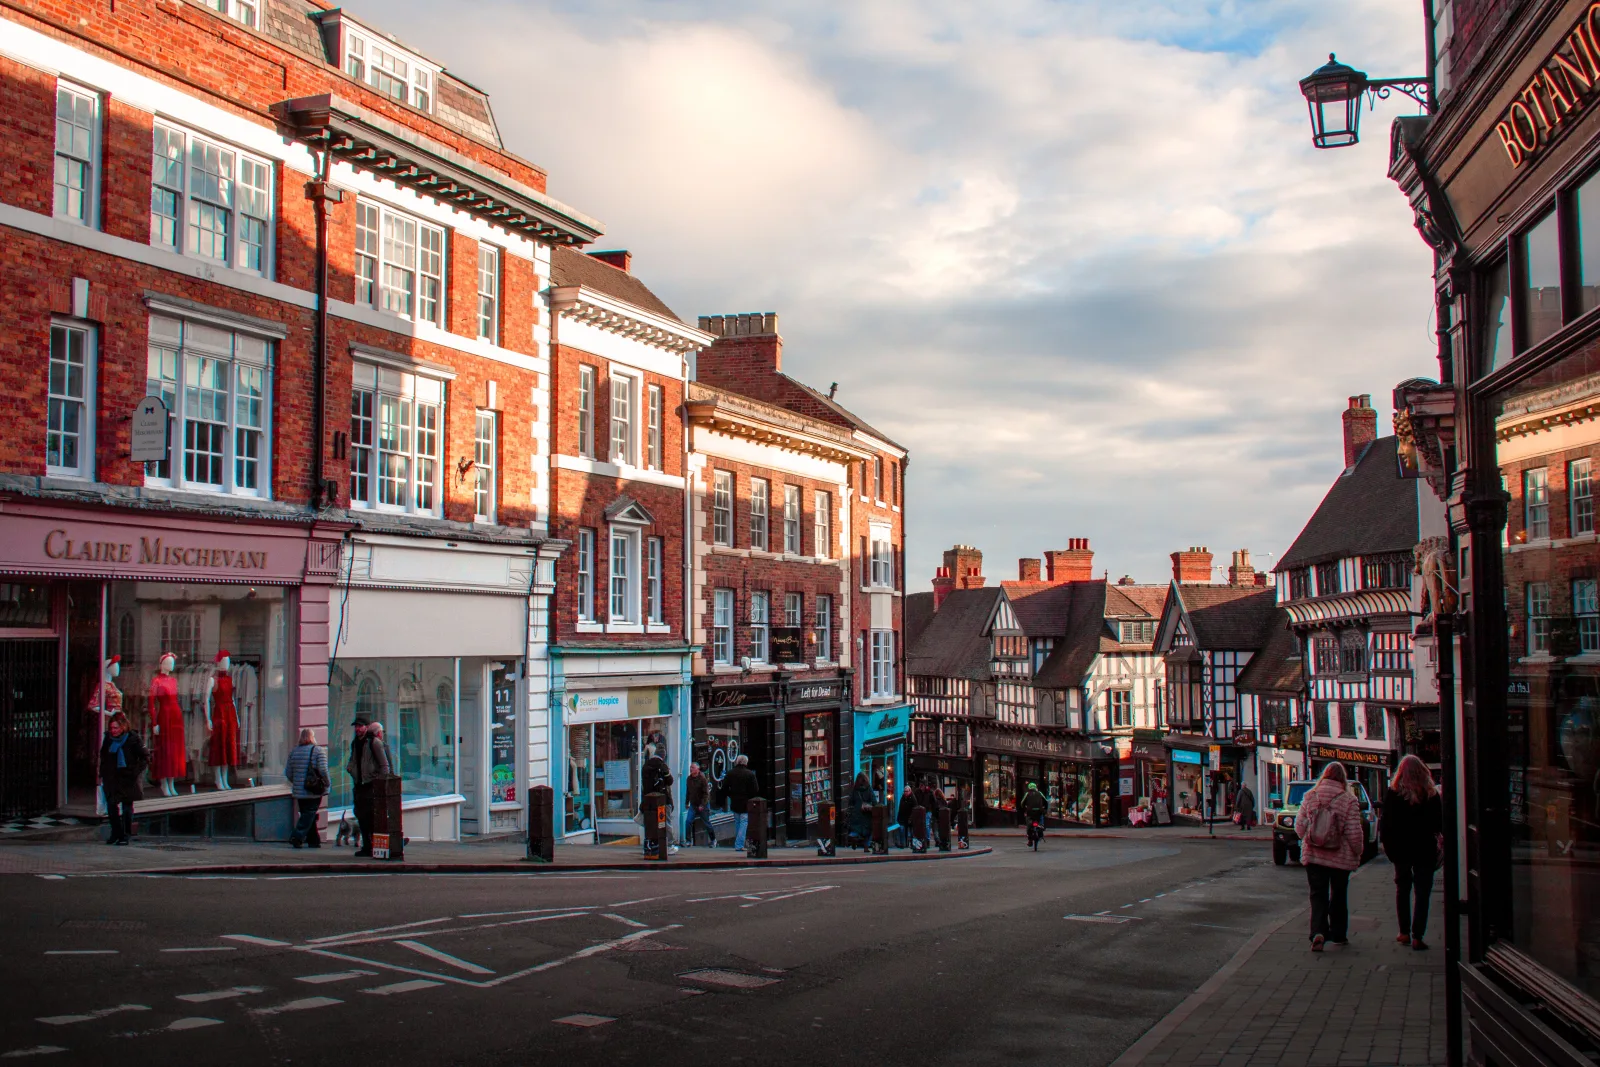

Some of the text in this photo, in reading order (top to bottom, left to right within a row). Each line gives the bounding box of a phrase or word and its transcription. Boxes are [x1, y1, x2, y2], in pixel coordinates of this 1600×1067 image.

[44, 529, 269, 569] CLAIRE MISCHEVANI
[800, 686, 831, 698] Left for Dead
[580, 695, 619, 706] Severn Hospice
[1000, 737, 1063, 752] TUDOR GALLERIES
[1319, 746, 1336, 758] HENRY
[1335, 748, 1353, 760] TUDOR
[1353, 751, 1363, 761] INN
